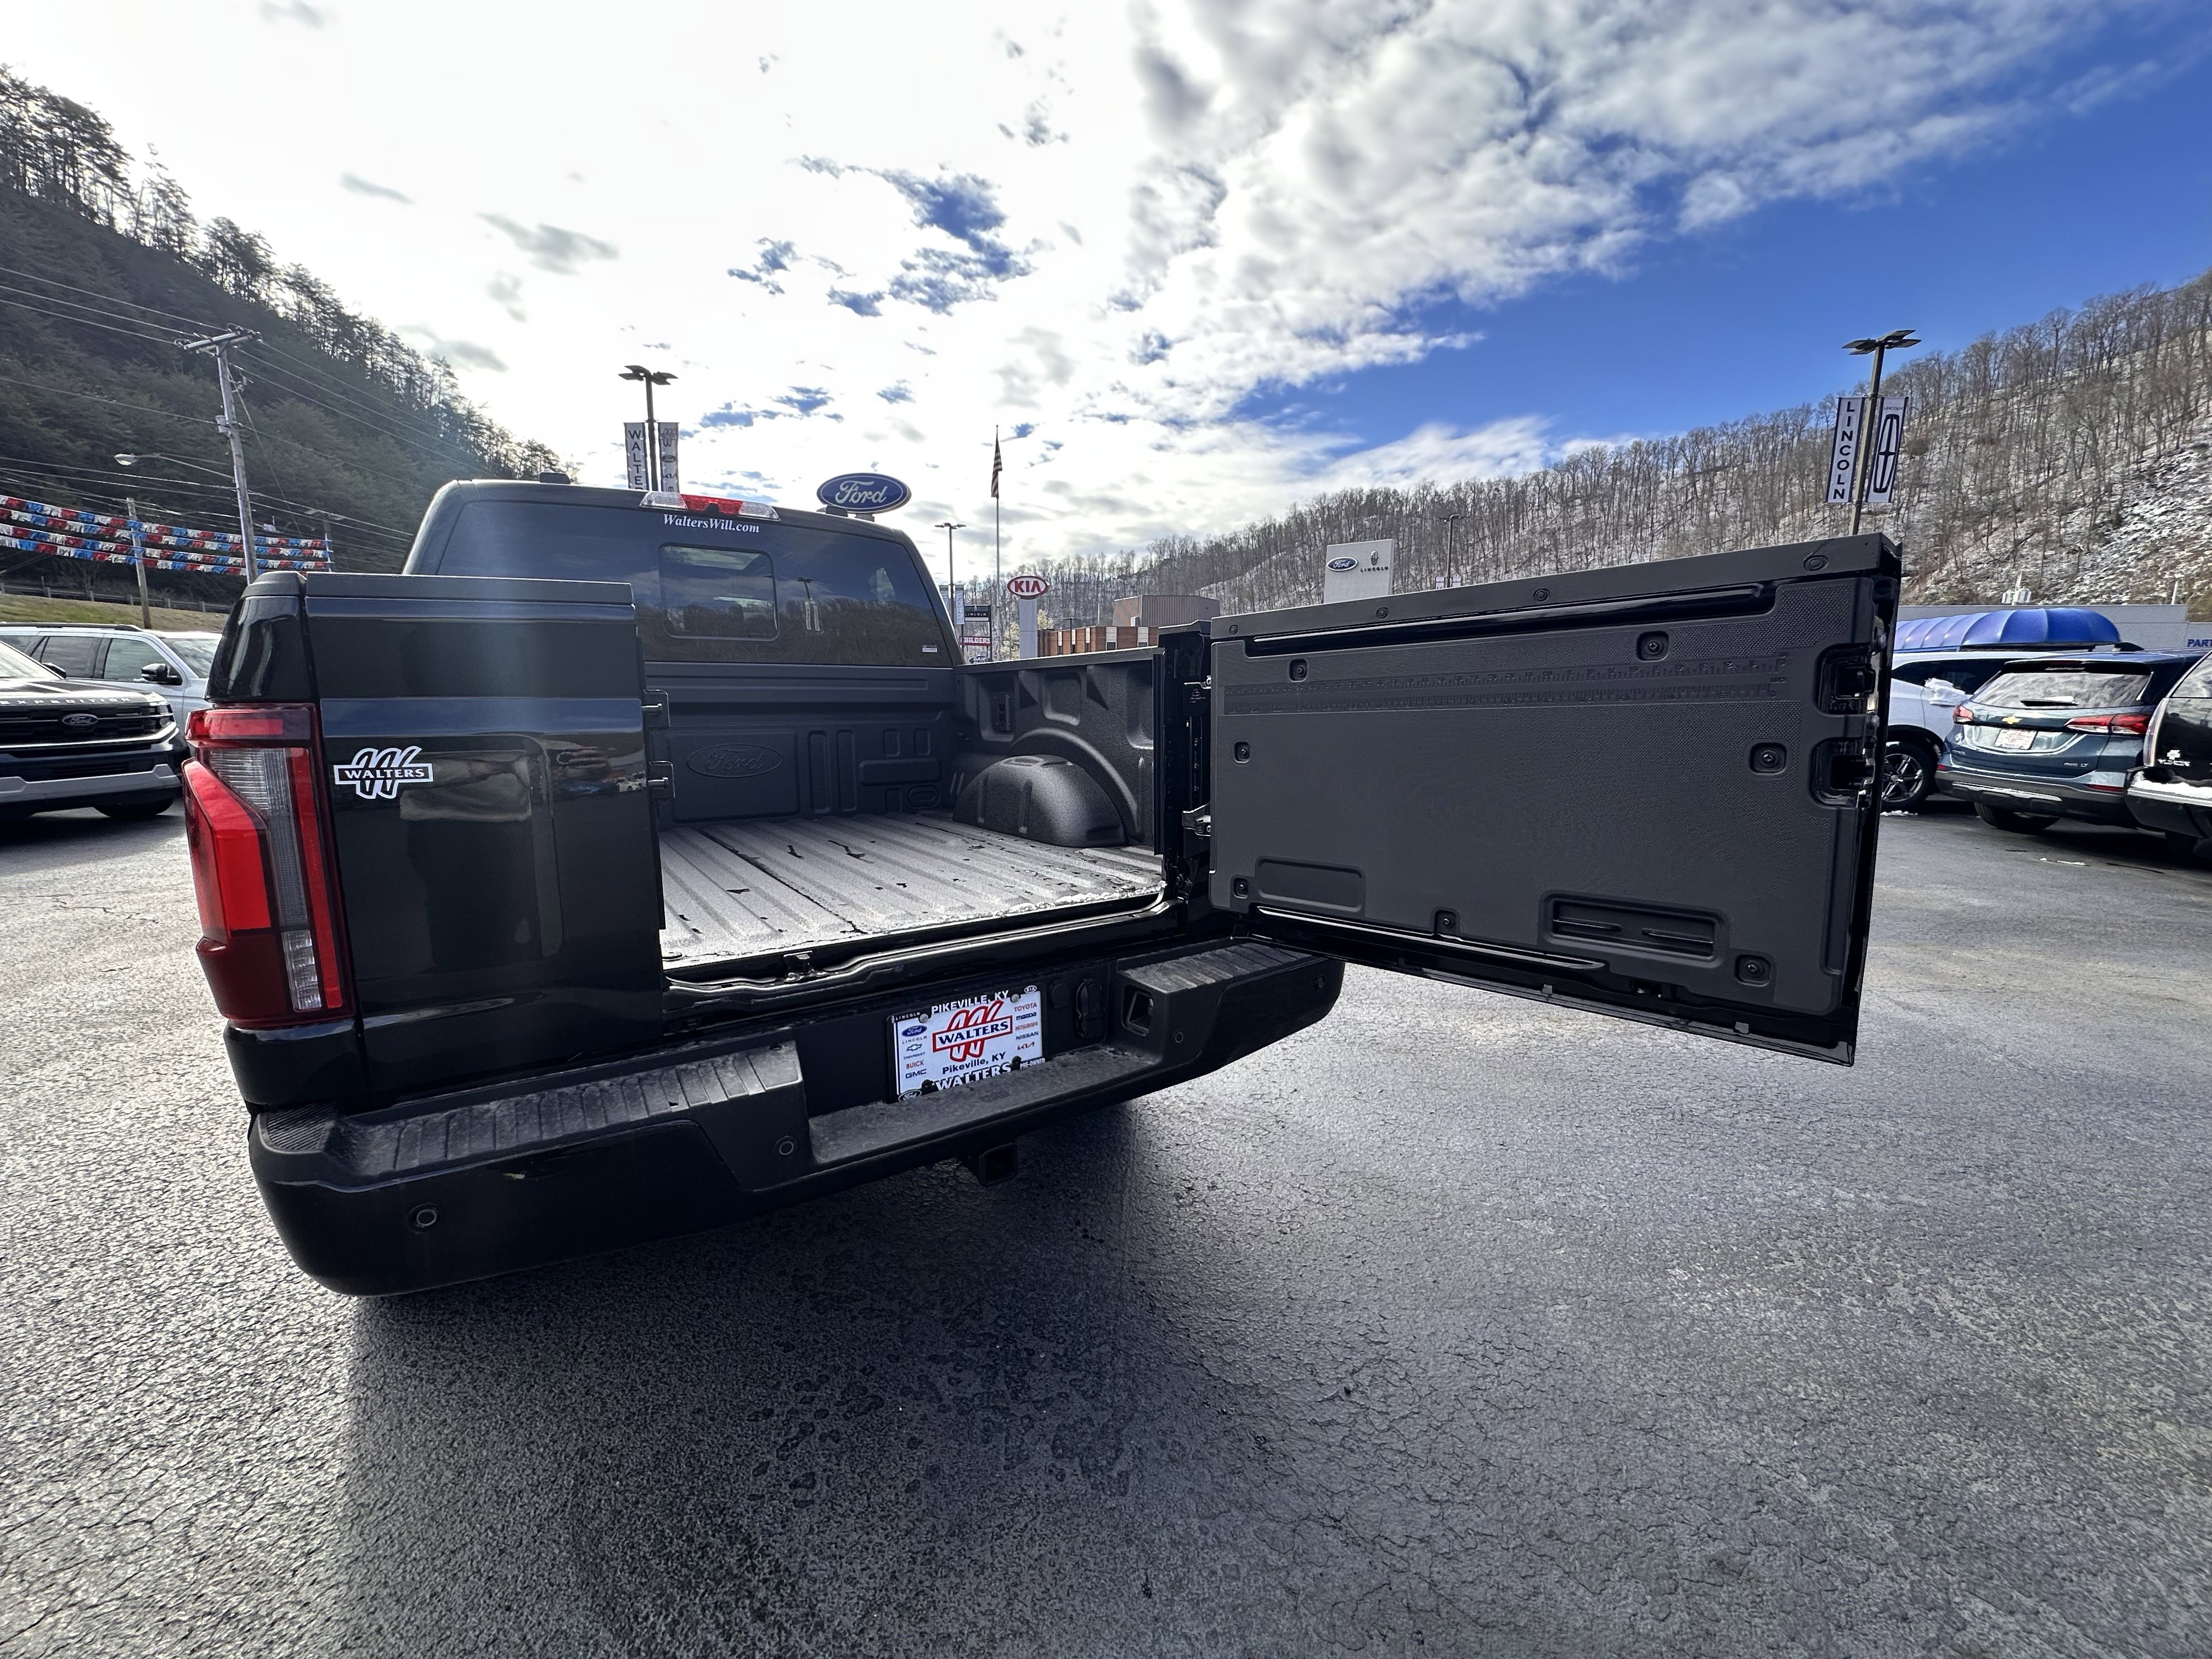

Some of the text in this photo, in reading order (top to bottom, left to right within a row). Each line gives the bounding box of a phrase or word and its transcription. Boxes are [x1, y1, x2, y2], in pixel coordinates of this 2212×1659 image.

[1833, 401, 1855, 499] LINCOLN
[628, 430, 643, 490] WALTE
[834, 480, 888, 504] Ford
[663, 514, 759, 533] WaltersWill.com
[1333, 560, 1350, 568] Ford
[1014, 580, 1040, 592] KIA
[706, 748, 764, 771] Ford
[345, 769, 425, 778] WALTERS
[932, 990, 1009, 1014] PIKEVILLE, KY
[1014, 1002, 1037, 1012] TOYOTA
[895, 1012, 920, 1020] LINCOLN
[907, 1026, 922, 1035] Ford
[938, 1021, 1008, 1045] WALTERS
[1015, 1031, 1039, 1040] NISSAN
[902, 1035, 927, 1044] LINCOLN
[906, 1060, 924, 1069] BUICK
[942, 1051, 1006, 1075] Pikeville, KY
[905, 1069, 927, 1079] GMC
[935, 1063, 1011, 1092] WALTERS
